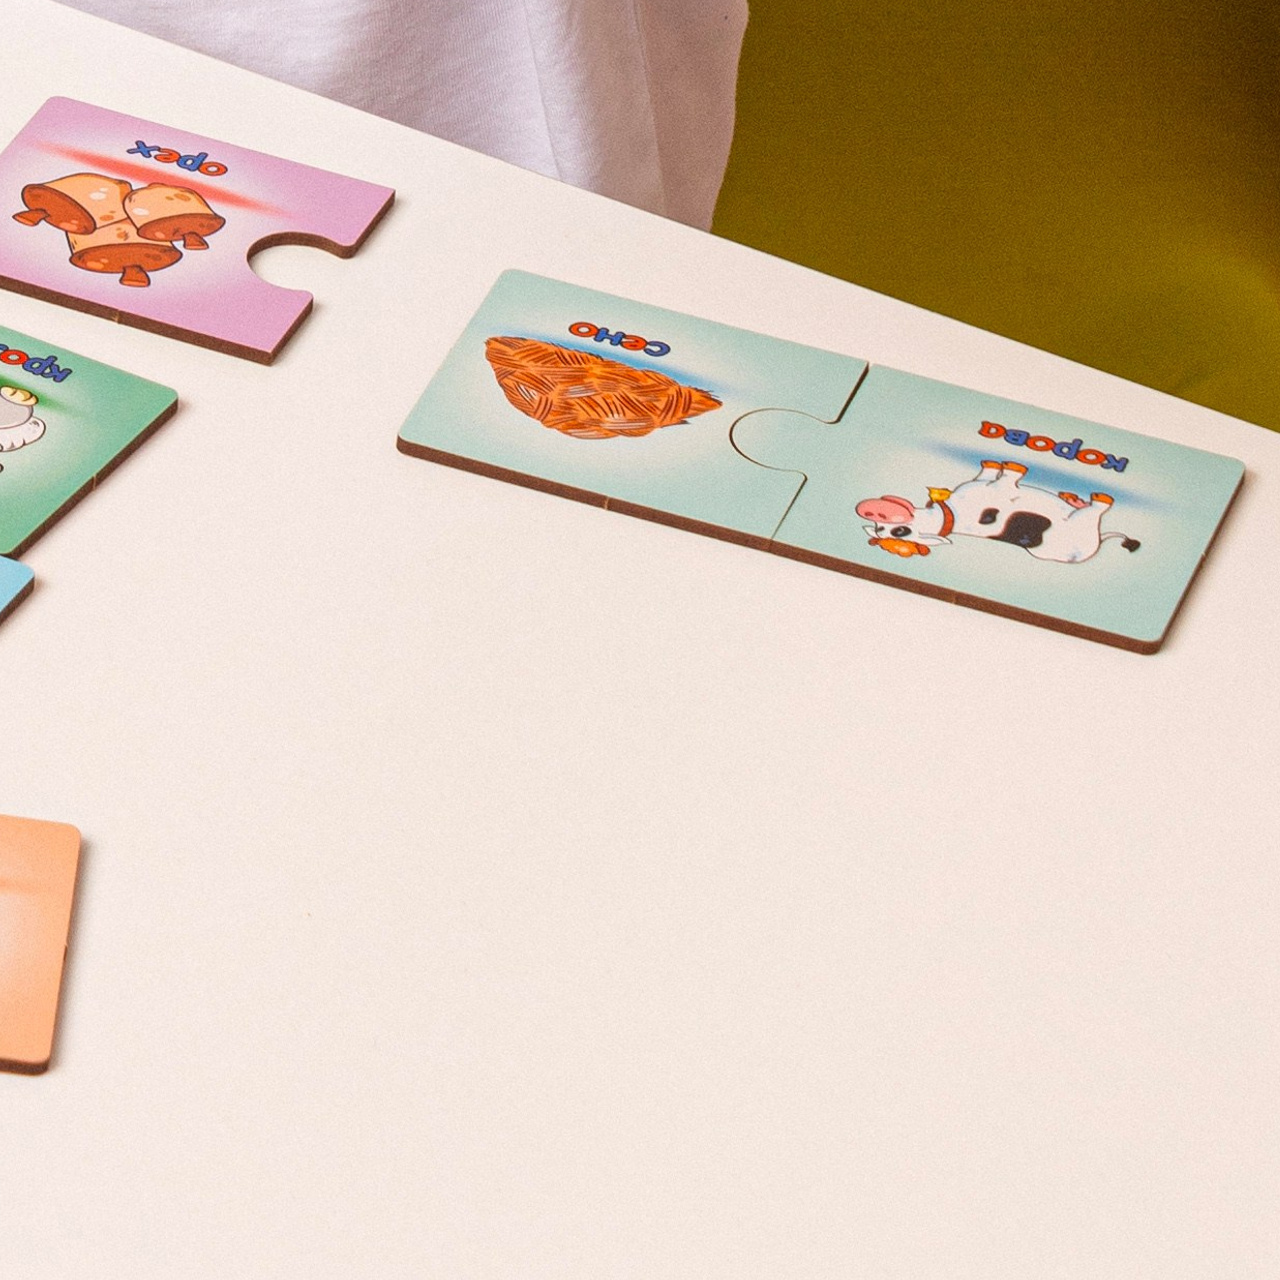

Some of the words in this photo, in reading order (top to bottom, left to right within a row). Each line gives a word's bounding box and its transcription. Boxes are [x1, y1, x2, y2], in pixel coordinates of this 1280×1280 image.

[126, 139, 228, 177] орех
[569, 320, 670, 358] сено
[979, 419, 1128, 474] корова
